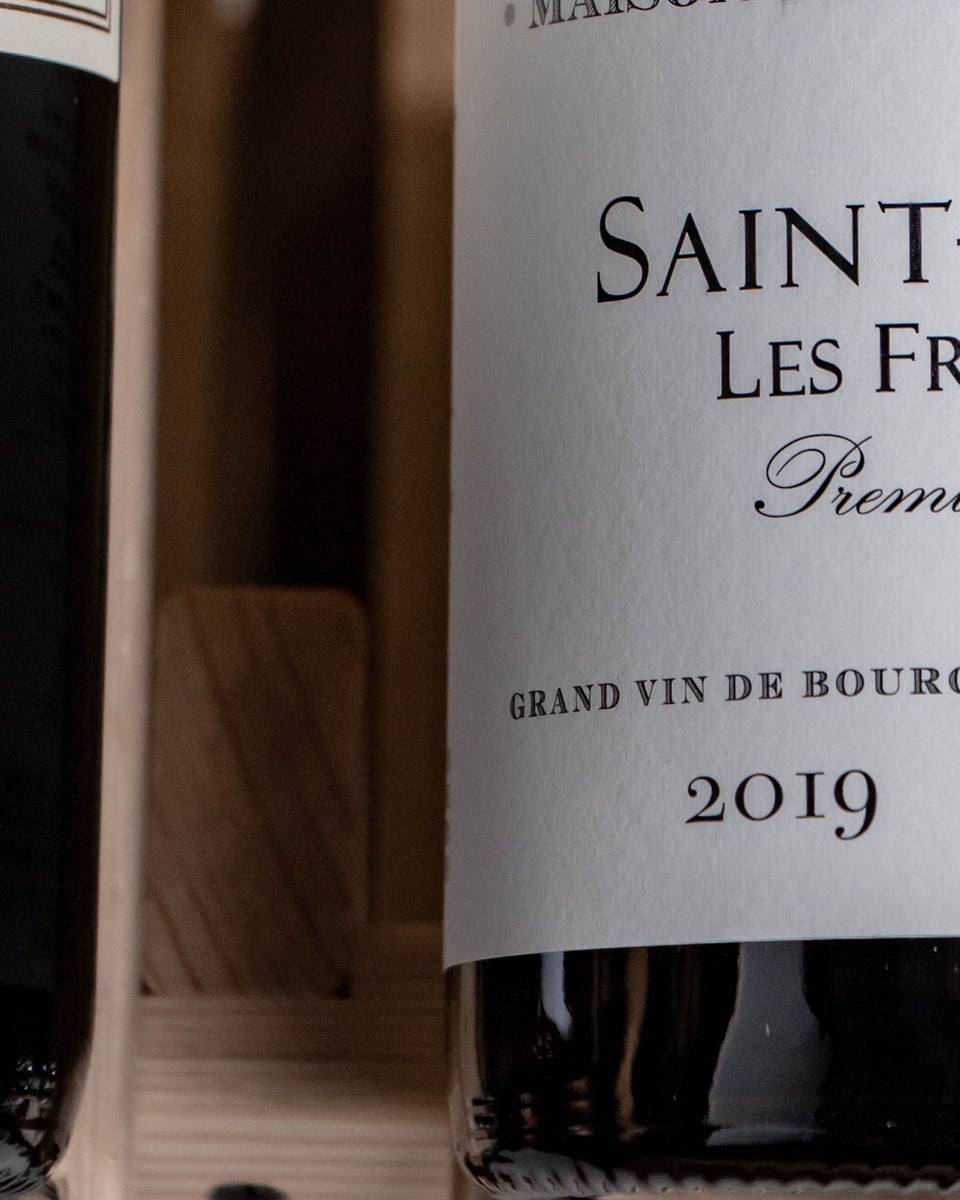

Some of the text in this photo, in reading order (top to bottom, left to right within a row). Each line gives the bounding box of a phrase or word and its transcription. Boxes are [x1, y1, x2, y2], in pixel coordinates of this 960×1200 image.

[715, 330, 843, 401] LES
[509, 682, 621, 721] GRAND
[634, 675, 708, 707] VIN
[724, 671, 783, 702] DE
[684, 768, 878, 841] 2019
